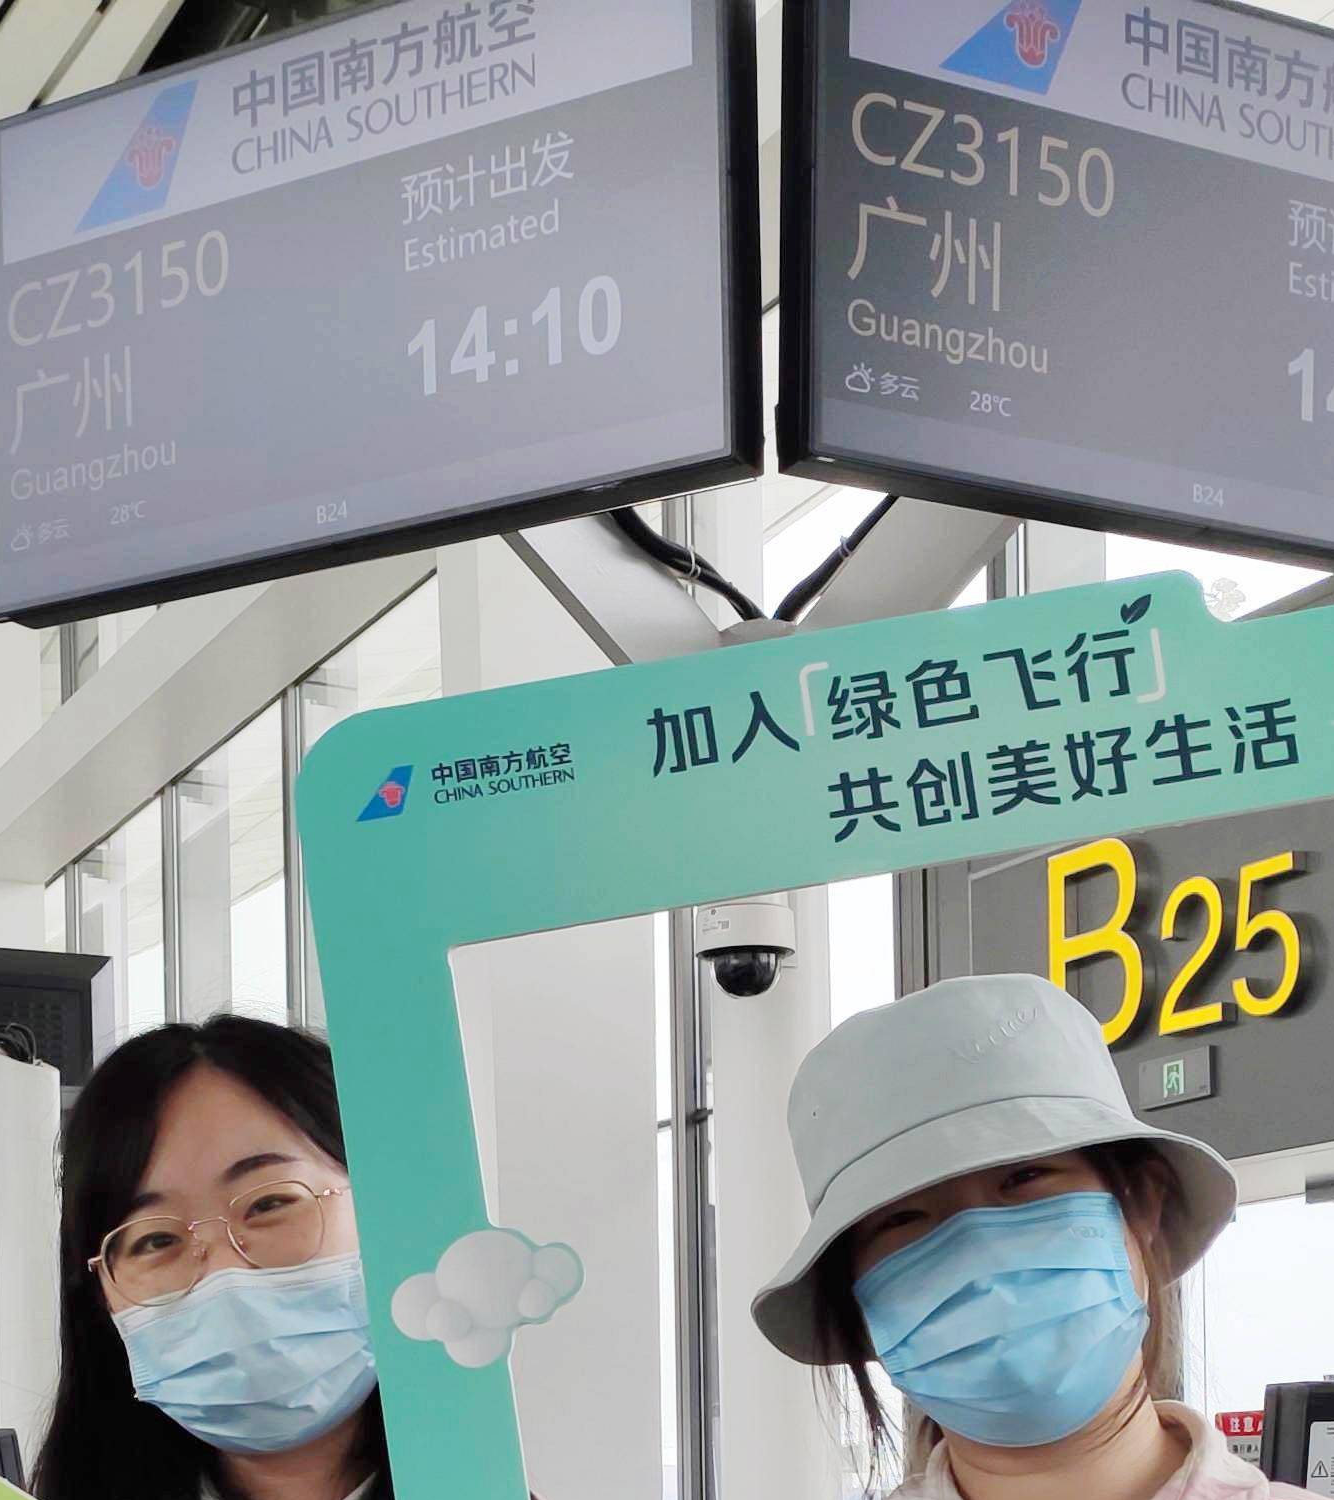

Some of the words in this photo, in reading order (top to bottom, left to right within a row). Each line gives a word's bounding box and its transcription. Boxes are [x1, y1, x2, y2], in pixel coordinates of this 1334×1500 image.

[232, 0, 536, 128] 中国南方航空
[1121, 72, 1226, 132] CHINA
[231, 115, 333, 175] CHINA
[347, 52, 536, 142] SOUTHERN
[851, 92, 1114, 218] CZ3150
[400, 131, 575, 225] 预计出发
[404, 198, 560, 272] Estimated
[847, 195, 1001, 312] 广州
[8, 230, 229, 347] CZ3150
[407, 275, 622, 396] 14:10
[847, 299, 1049, 374] Guangzhou
[9, 345, 133, 456] 广州
[879, 372, 920, 402] 多云
[10, 440, 177, 501] Guangzhou
[316, 500, 348, 525] B24
[1192, 483, 1225, 509] B24
[431, 742, 573, 786] 中国南方航空
[434, 783, 484, 804] CHINA
[488, 767, 575, 796] SOUTHERN
[827, 698, 1300, 843] 共创美好生活
[1047, 837, 1301, 1046] B25
